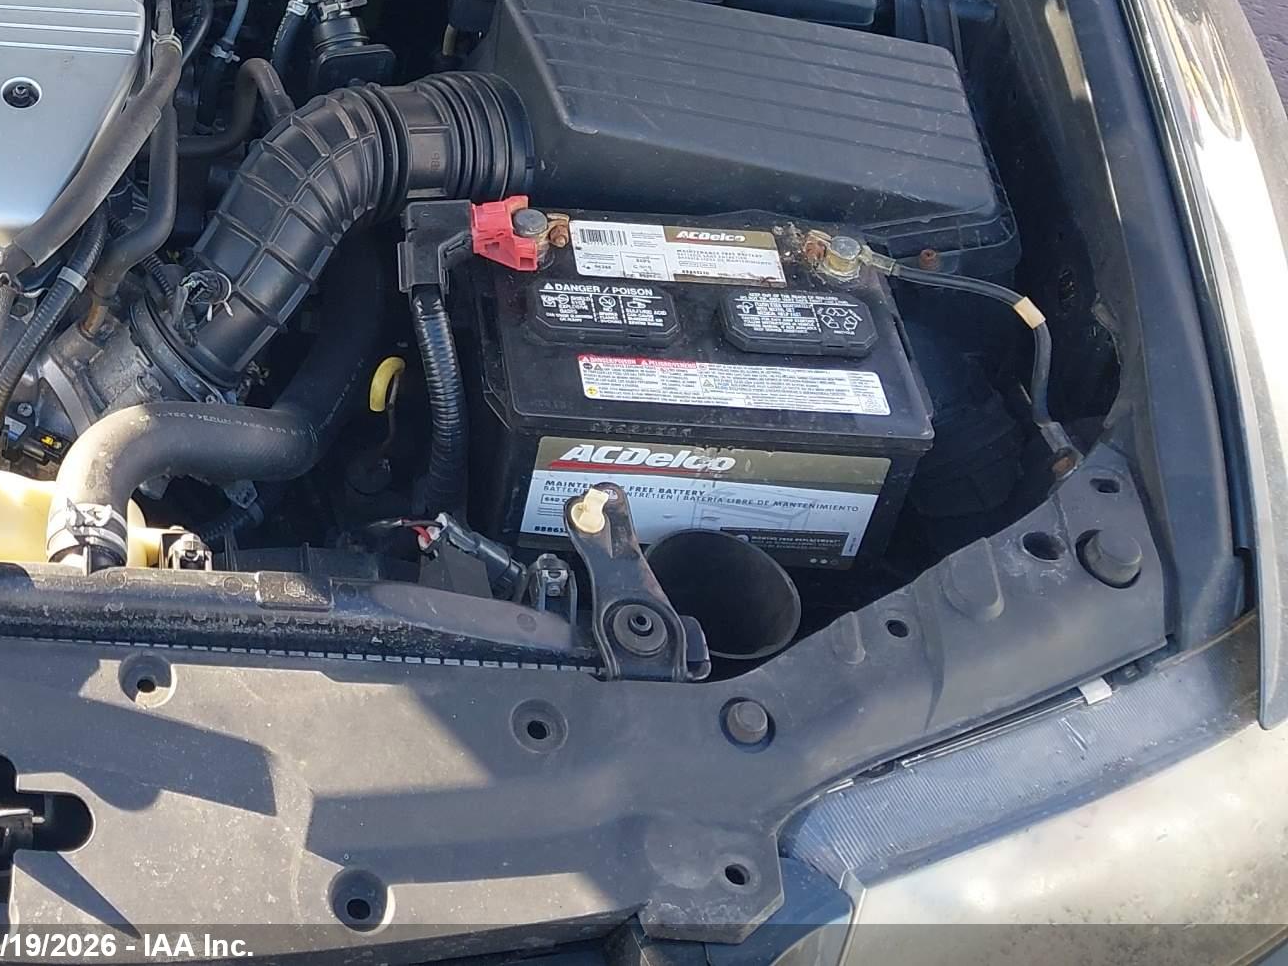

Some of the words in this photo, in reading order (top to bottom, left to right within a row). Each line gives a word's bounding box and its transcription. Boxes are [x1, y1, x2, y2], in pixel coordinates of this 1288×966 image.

[675, 230, 746, 242] ACDelco
[554, 283, 601, 293] DANGER
[612, 287, 653, 296] POISON
[558, 444, 737, 472] ACDelco
[629, 485, 654, 493] FREE
[659, 488, 706, 496] BATTERY
[626, 491, 673, 500] NTRETIEN
[726, 498, 753, 506] LIBRE
[773, 501, 859, 512] MANTENIMIENTO
